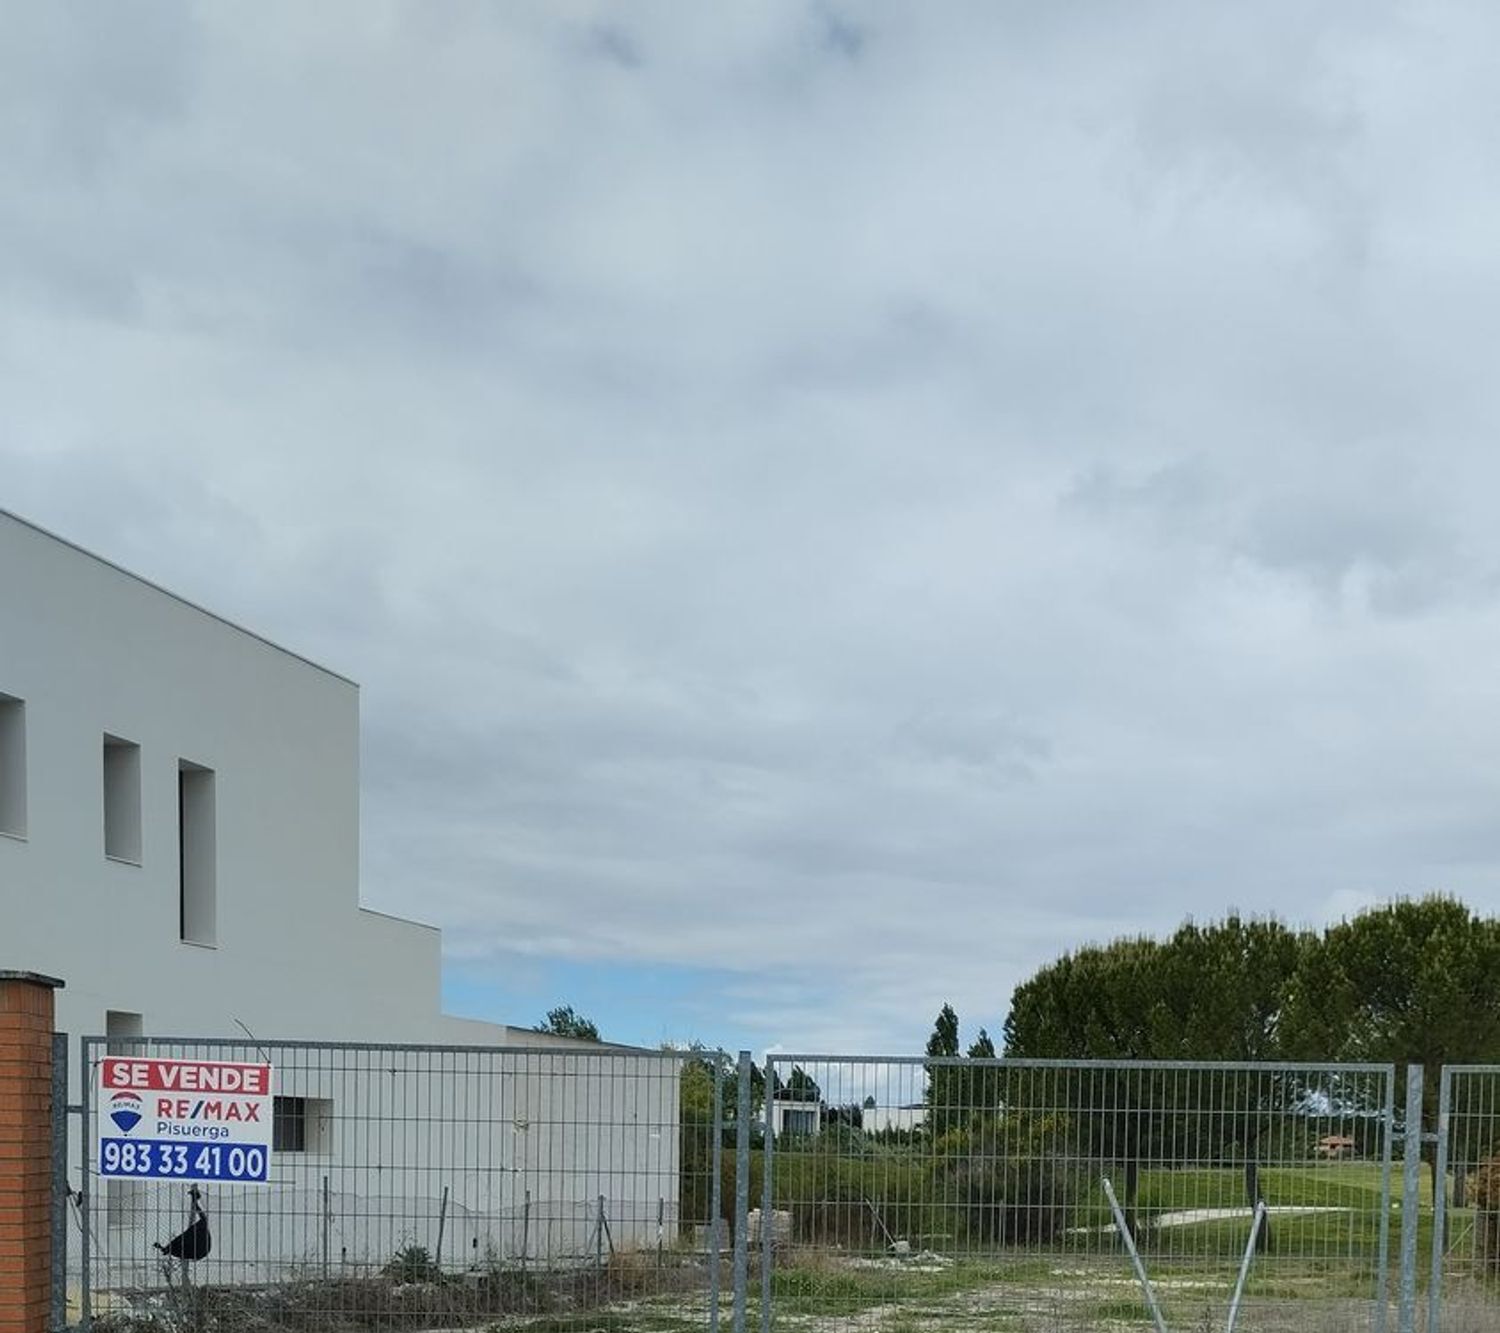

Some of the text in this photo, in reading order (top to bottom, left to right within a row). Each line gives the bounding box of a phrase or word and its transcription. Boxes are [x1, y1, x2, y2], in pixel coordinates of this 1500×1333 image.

[112, 1063, 260, 1092] SE VENDE
[157, 1098, 260, 1122] RE/MAX
[157, 1121, 229, 1140] Pisuerga
[104, 1142, 263, 1177] 983 33 41 00
